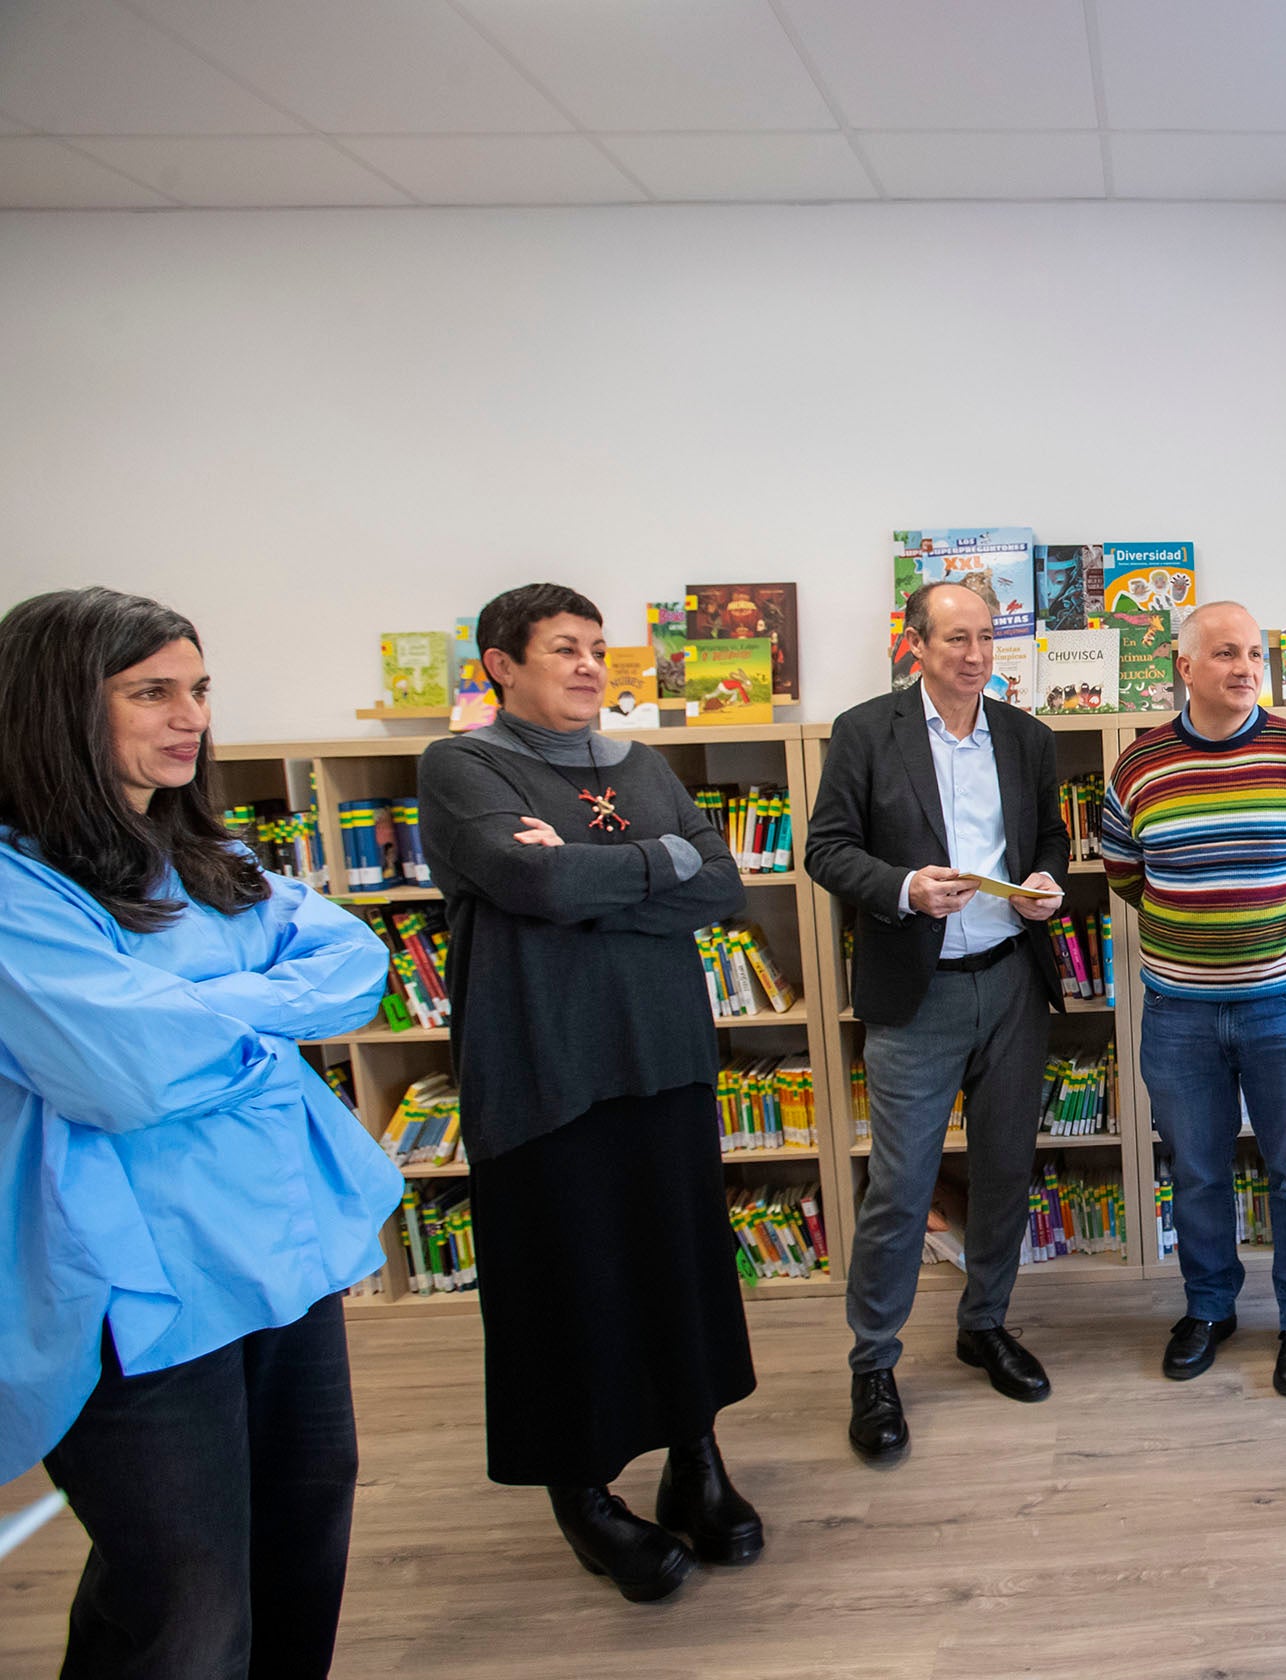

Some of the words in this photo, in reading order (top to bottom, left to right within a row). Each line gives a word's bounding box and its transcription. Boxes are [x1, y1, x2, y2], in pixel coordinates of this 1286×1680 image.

[930, 543, 1026, 557] SUPERPREGUNTONES
[1116, 549, 1182, 561] Diversidad
[944, 556, 984, 571] XXL
[1123, 637, 1136, 646] En
[1047, 650, 1104, 662] CHUVISCA
[391, 1002, 406, 1022] L
